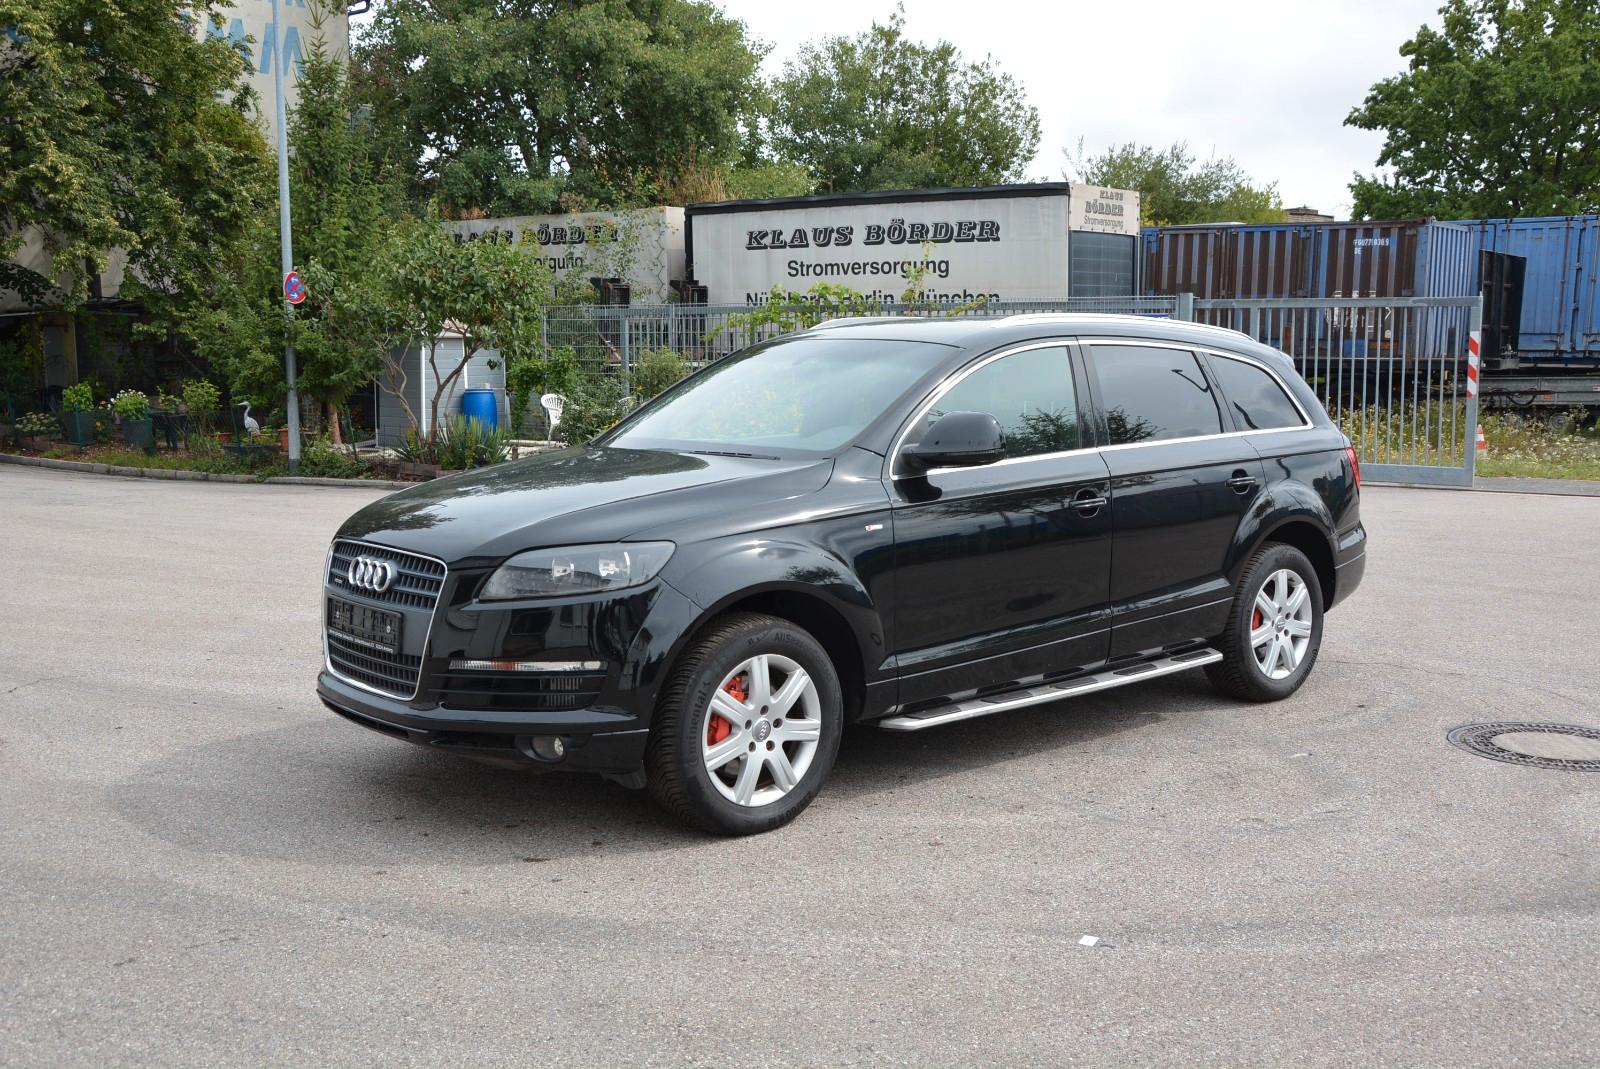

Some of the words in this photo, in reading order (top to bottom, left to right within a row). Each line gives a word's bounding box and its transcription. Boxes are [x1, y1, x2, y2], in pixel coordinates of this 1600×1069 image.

[745, 225, 854, 250] KLAUS
[863, 218, 1001, 246] BÖRDER
[787, 259, 950, 279] Stromversorgung
